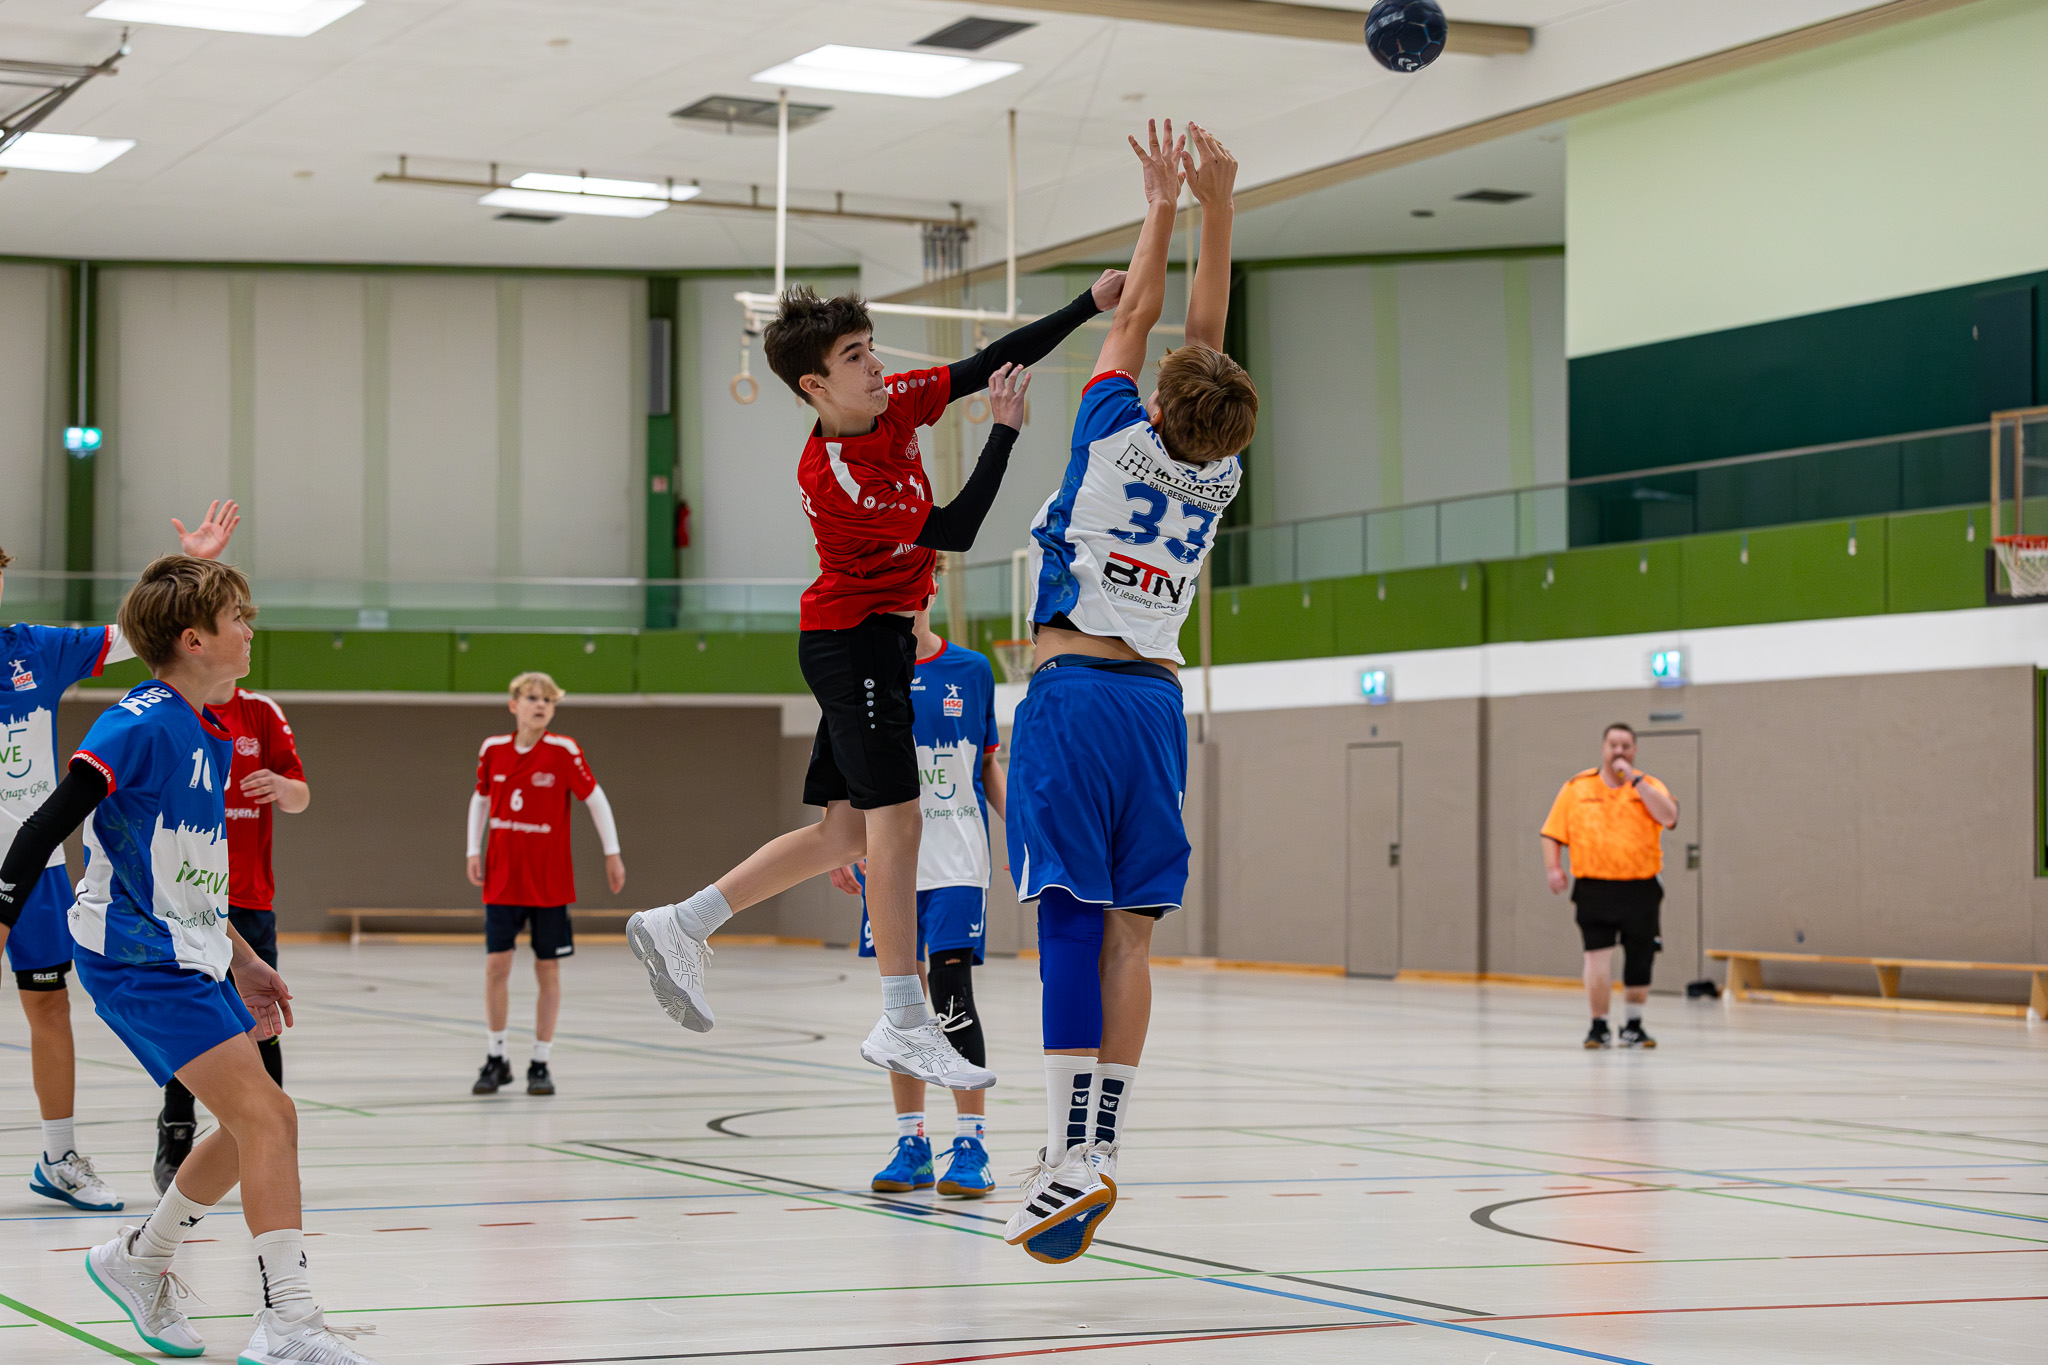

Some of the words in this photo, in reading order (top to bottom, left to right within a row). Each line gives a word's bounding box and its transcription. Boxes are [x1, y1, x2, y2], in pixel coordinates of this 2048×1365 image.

[1106, 481, 1217, 564] 33
[1101, 580, 1119, 595] BTN
[1103, 551, 1187, 604] BTN
[13, 675, 33, 686] HSG
[119, 687, 173, 717] HSG
[944, 700, 962, 708] HSG
[510, 788, 524, 812] 6
